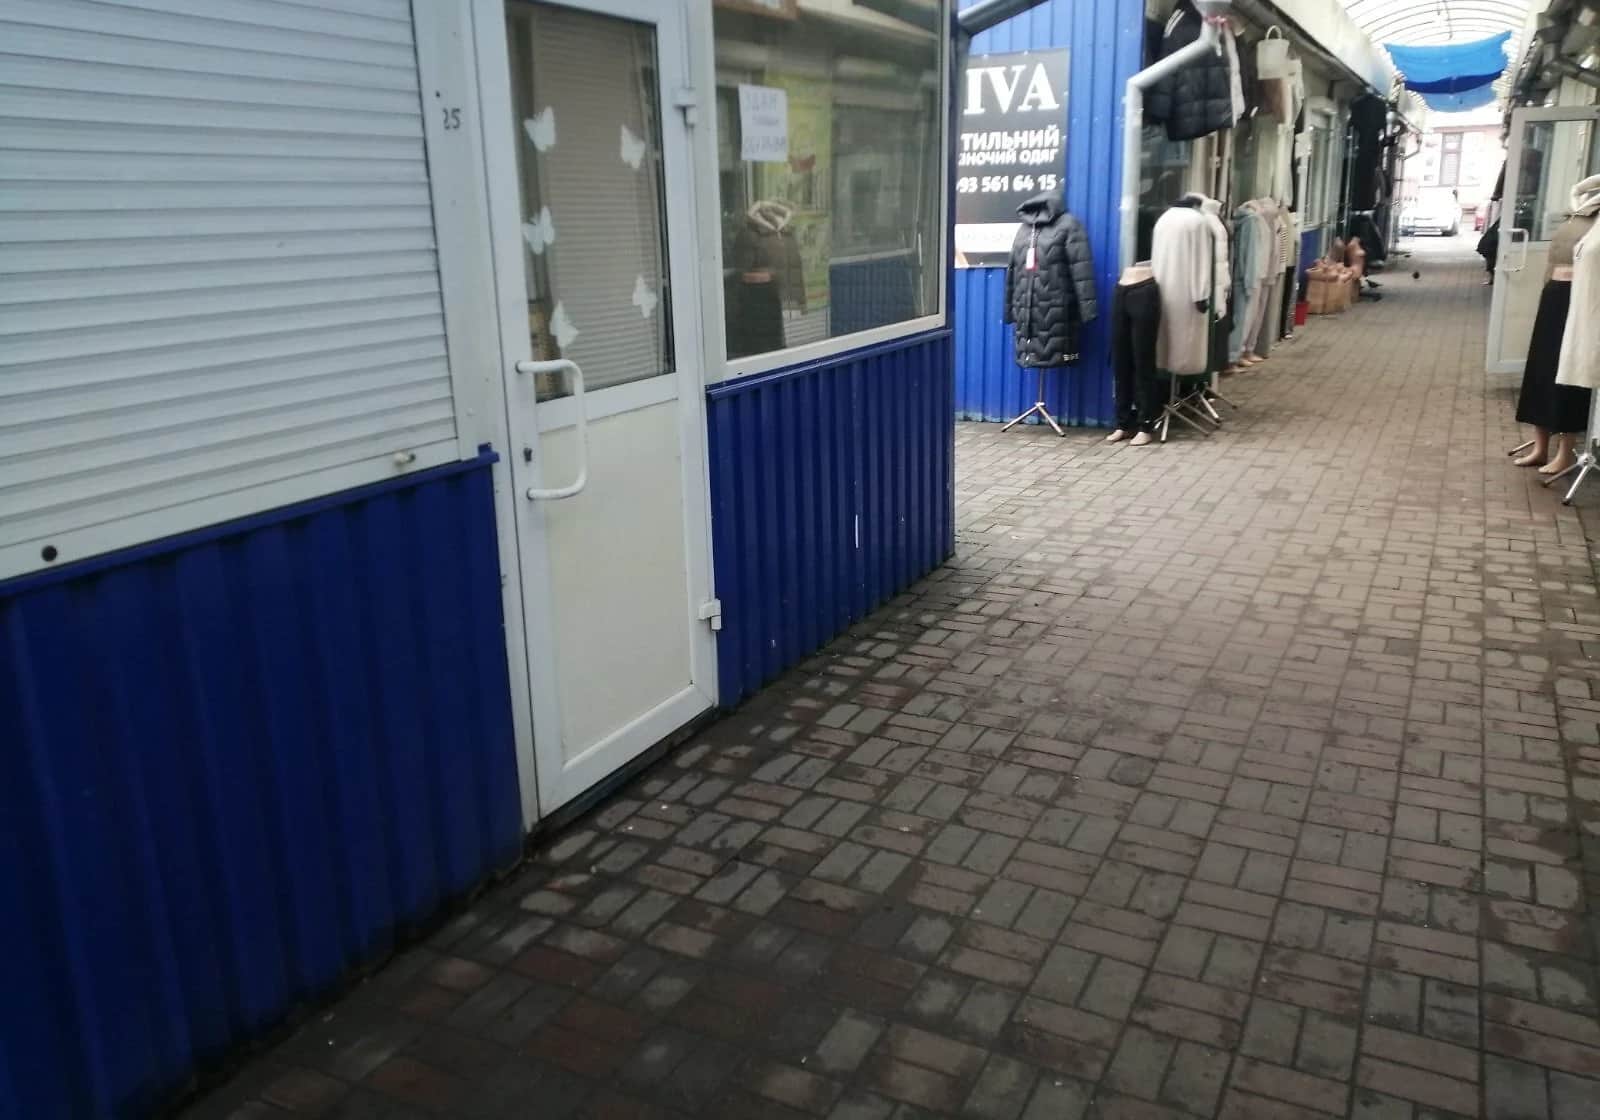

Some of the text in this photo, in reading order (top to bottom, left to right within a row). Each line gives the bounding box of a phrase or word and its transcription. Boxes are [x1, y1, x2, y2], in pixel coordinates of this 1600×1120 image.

[964, 63, 1060, 116] IVA
[442, 107, 461, 130] 25
[960, 124, 1060, 151] ТИЛЬНИЙ
[956, 174, 1057, 193] 93 561 64 15
